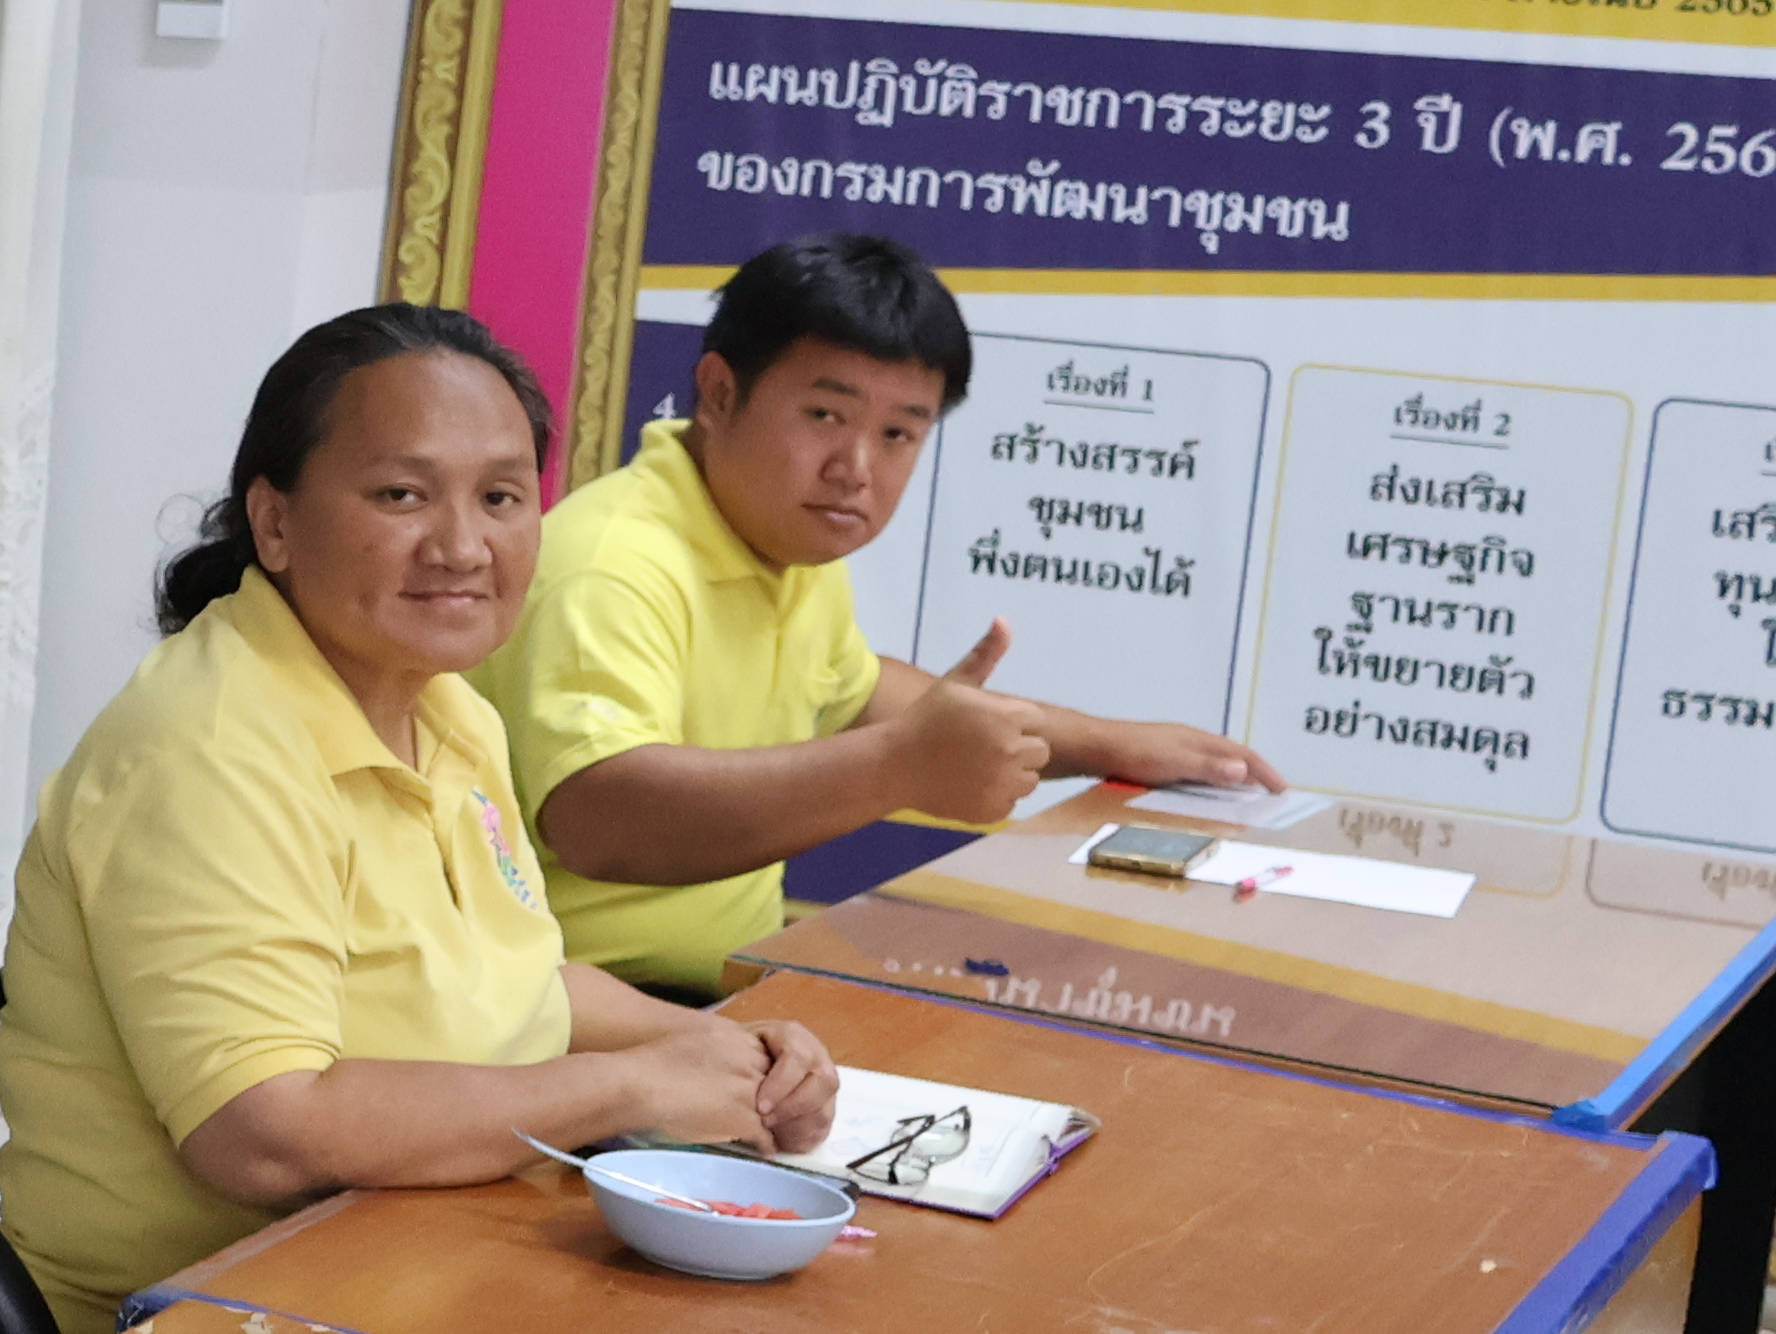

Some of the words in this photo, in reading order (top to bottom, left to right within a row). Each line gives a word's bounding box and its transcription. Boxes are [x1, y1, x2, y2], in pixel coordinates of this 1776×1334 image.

[708, 56, 1332, 144] แผนปฏิบัติราชการระยะ
[1354, 99, 1392, 151] 3
[1413, 92, 1463, 156] ปี
[696, 149, 1350, 256] ของกรมการพัฒนาชุมชน
[1046, 359, 1130, 399] เรื่องที่
[1394, 392, 1483, 435] เรื่องที่
[1494, 413, 1512, 438] 2
[989, 422, 1201, 481] สร้างสรรค์
[1027, 493, 1145, 539] ชุมชน
[1368, 465, 1526, 517] ส่งเสริม
[966, 529, 1196, 599] พึ่งตนเองได้
[1346, 531, 1536, 586] เศรษฐกิจ
[1349, 589, 1516, 637] ฐานราก
[1312, 626, 1536, 700] ให้ขยายตัว
[1303, 698, 1531, 773] อย่างสมดุล
